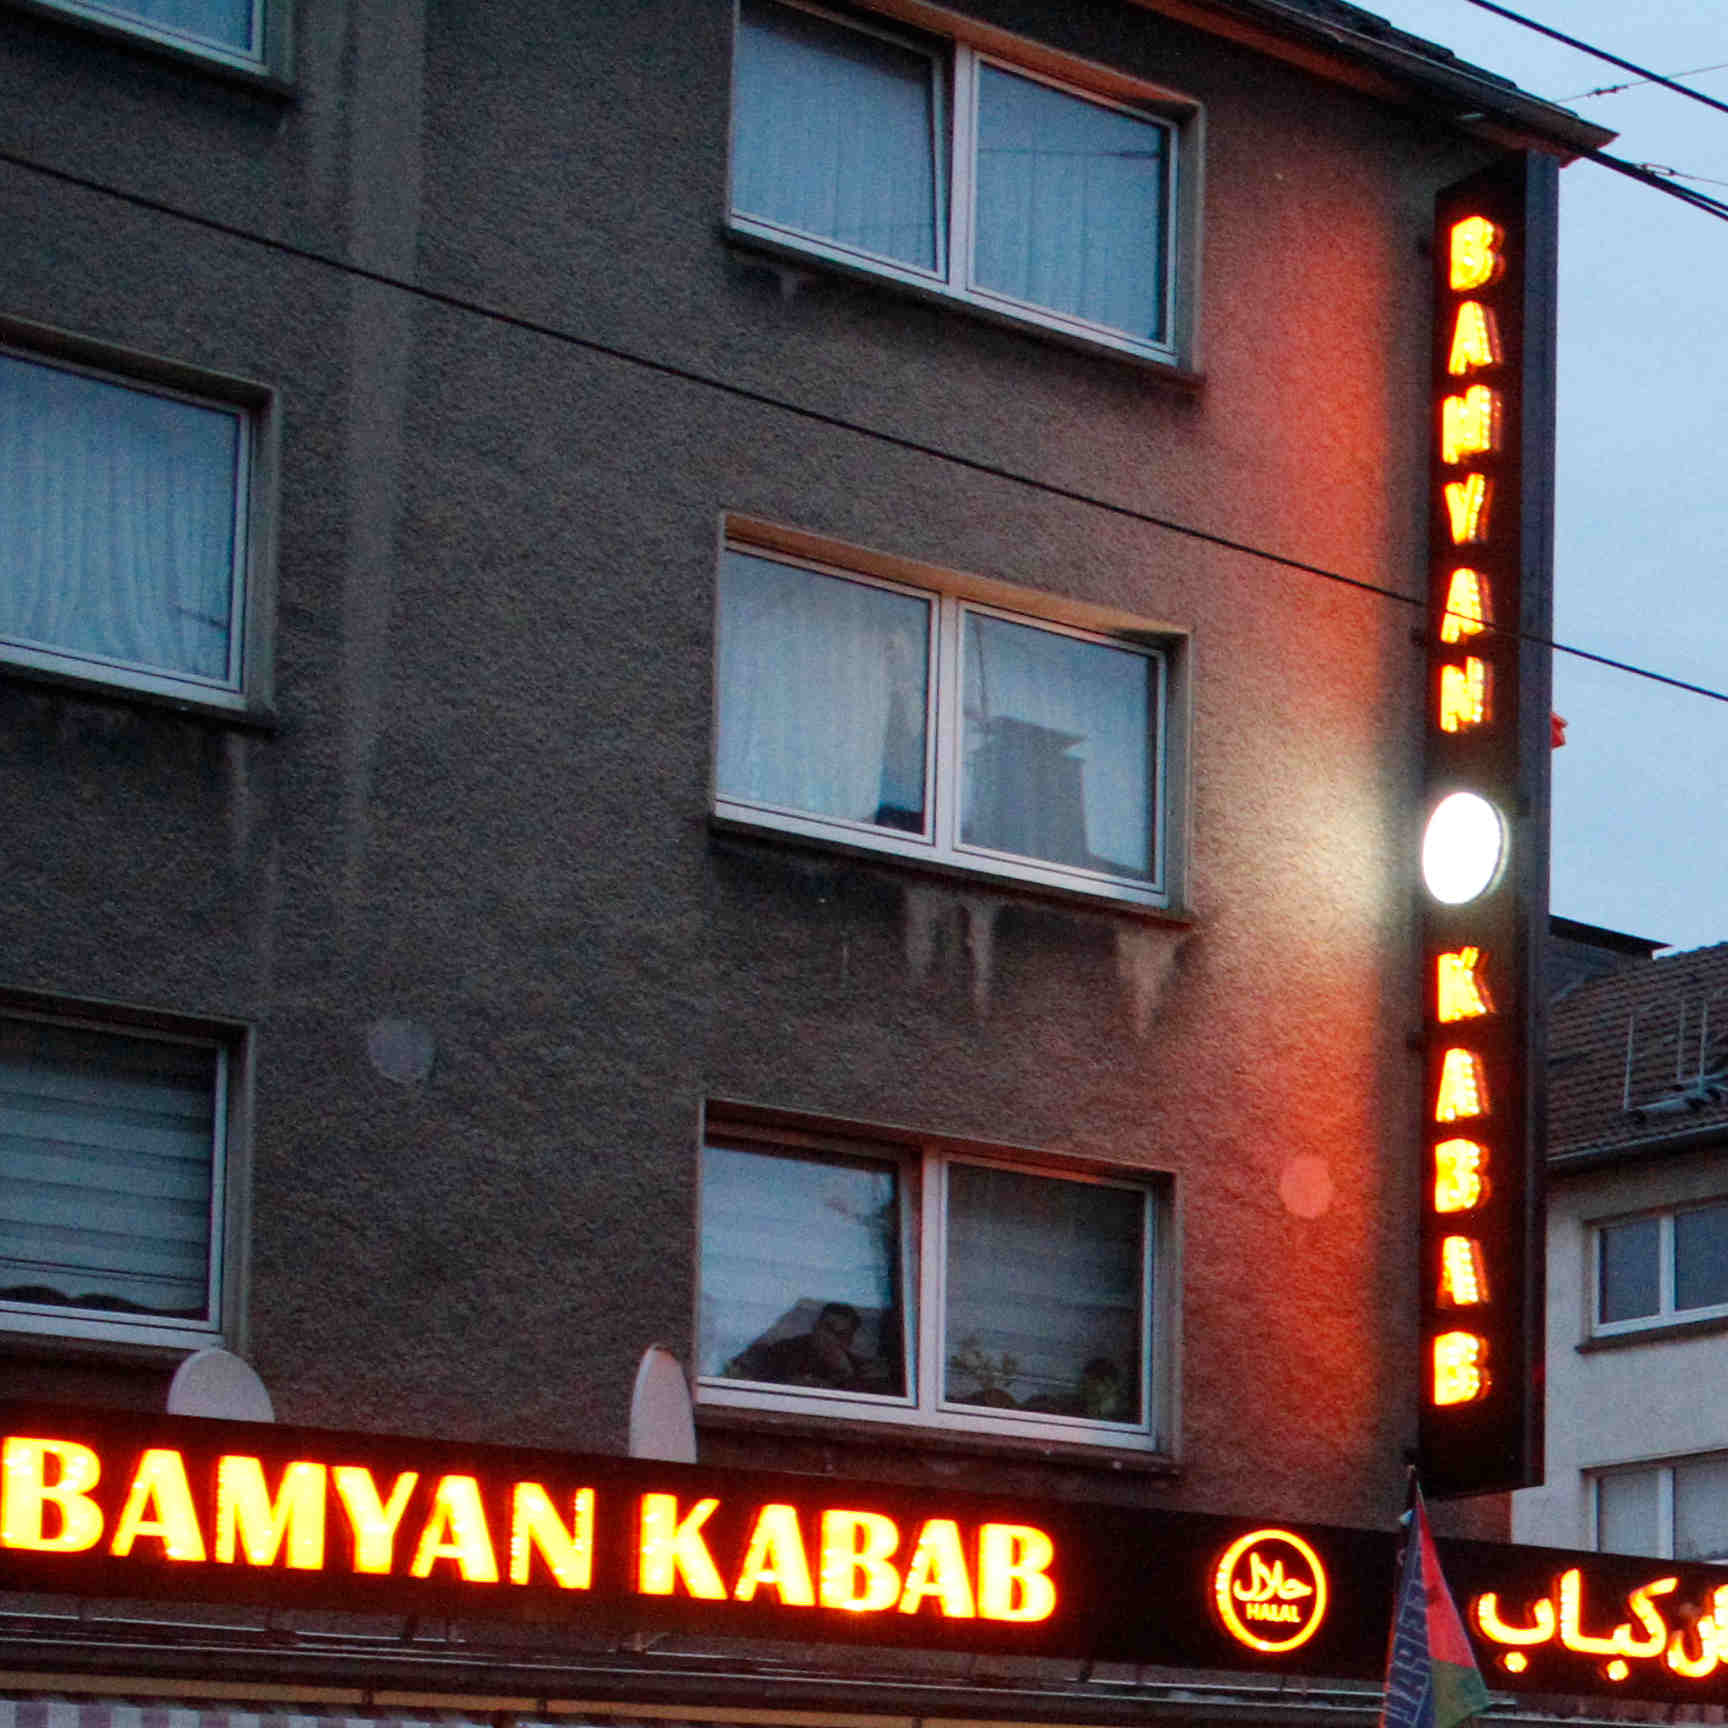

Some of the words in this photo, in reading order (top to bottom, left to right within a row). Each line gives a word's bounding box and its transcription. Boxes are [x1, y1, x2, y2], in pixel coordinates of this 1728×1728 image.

[1440, 214, 1502, 734] BAMYAN
[1433, 946, 1494, 1406] KABAB
[0, 1434, 596, 1591] BAMYAN
[636, 1491, 1058, 1624] KABAB
[1233, 1551, 1313, 1602] حلال
[1246, 1602, 1301, 1623] HALAL
